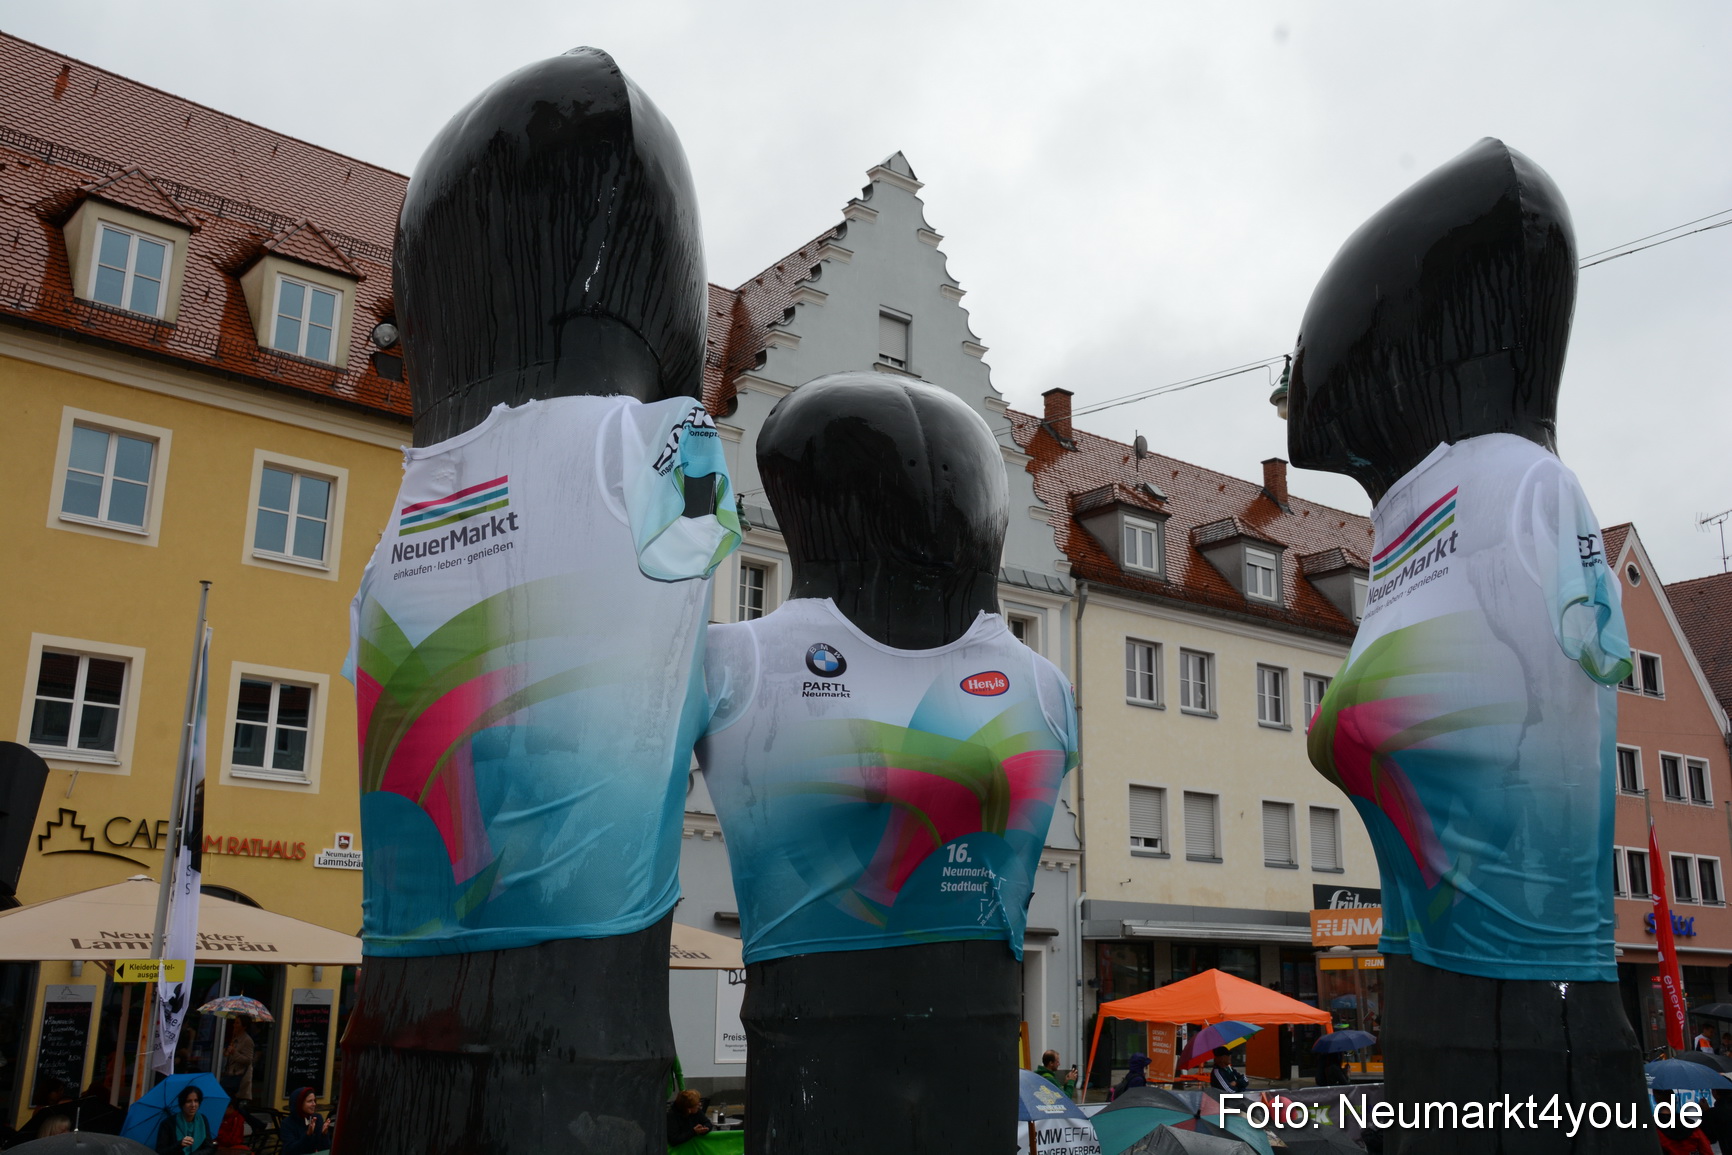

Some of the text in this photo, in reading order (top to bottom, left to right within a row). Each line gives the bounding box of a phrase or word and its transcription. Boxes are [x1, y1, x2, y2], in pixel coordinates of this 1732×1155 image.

[391, 511, 519, 564] NeuerMarkt
[393, 541, 514, 581] einkaufen leben genießen
[1366, 529, 1458, 607] NeuerMarkt
[1406, 566, 1449, 596] genießen
[809, 643, 843, 659] BMW
[802, 682, 850, 692] PARTL
[968, 677, 1005, 690] Hervis
[105, 816, 170, 850] CAF
[226, 836, 307, 860] RATHAUS
[325, 850, 361, 858] Neumarkter
[946, 843, 972, 863] 16.
[940, 880, 989, 894] Stadtlauf
[129, 964, 175, 972] Kleiderbetel-
